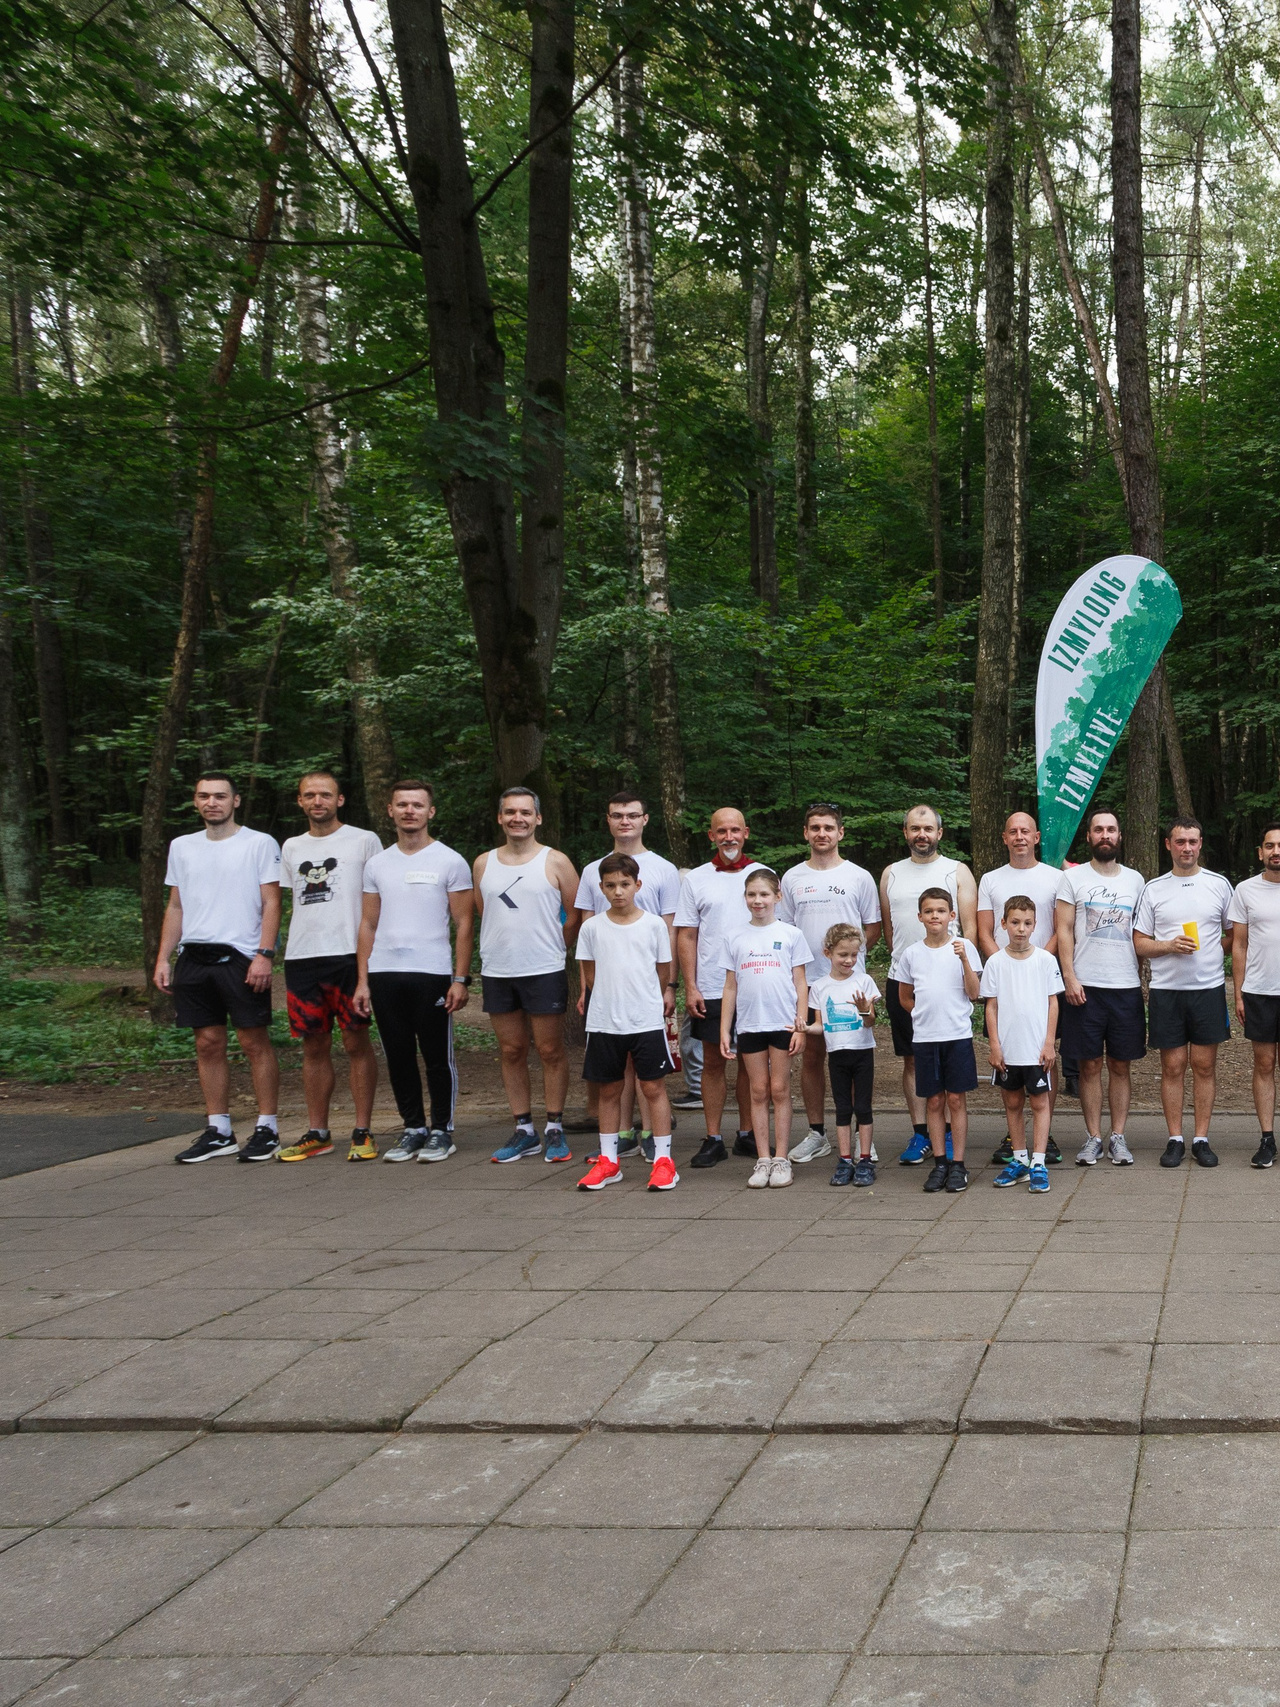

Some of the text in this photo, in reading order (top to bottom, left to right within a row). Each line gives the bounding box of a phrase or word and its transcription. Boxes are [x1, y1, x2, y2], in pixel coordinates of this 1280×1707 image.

[1047, 570, 1127, 673] IZMYLONG
[1055, 707, 1123, 812] IZMYFIVE
[1087, 885, 1133, 905] Play
[1091, 910, 1124, 933] Loud
